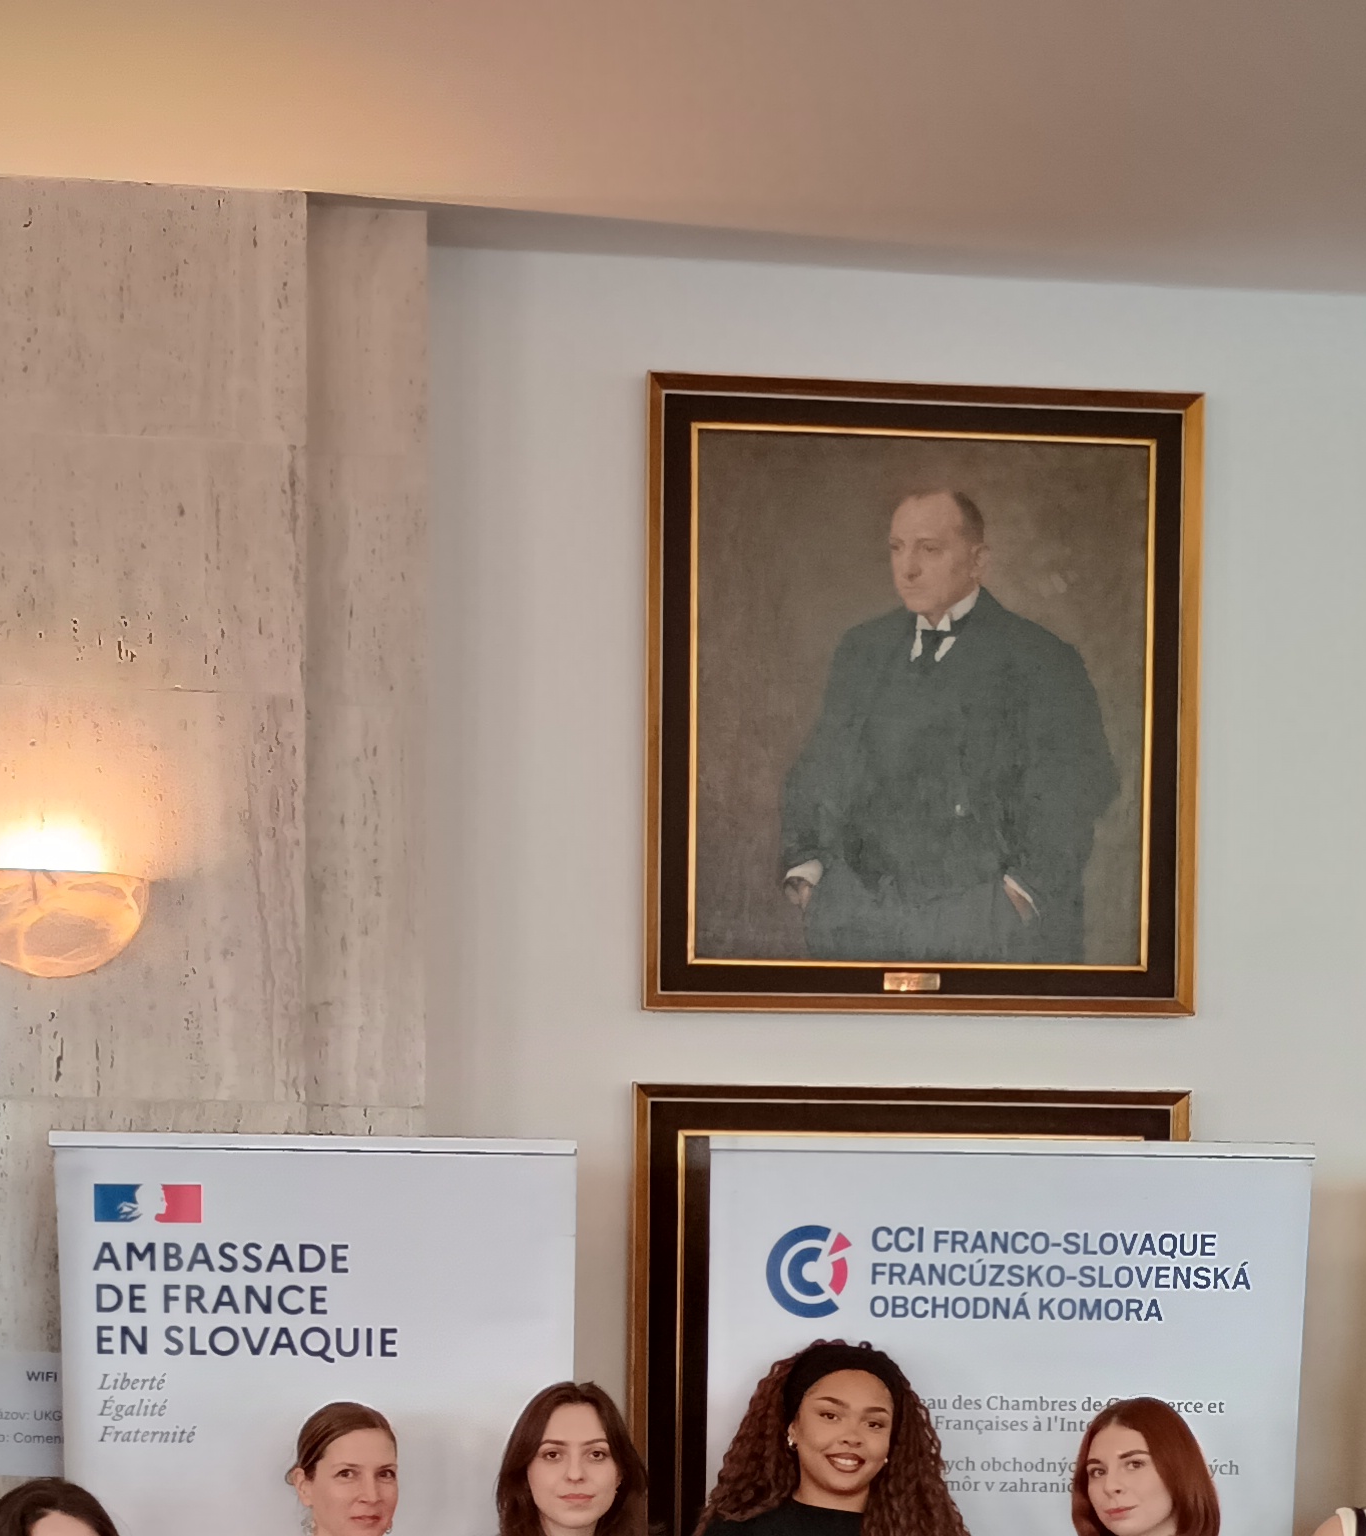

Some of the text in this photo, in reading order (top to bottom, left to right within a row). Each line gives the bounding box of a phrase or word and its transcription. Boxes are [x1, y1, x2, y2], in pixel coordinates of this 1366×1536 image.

[871, 1226, 1217, 1259] CCI FRANCO-SLOVAQUE
[93, 1242, 349, 1273] AMBASSADE
[870, 1258, 1252, 1291] FRANCÚZSKO-SLOVENSKÁ
[96, 1283, 328, 1315] DE FRANCE
[869, 1293, 1164, 1322] OBCHODNÁ KOMORA
[96, 1325, 398, 1363] EN SLOVAQUIE
[26, 1370, 58, 1382] WIFI
[97, 1372, 167, 1391] Liberté
[97, 1395, 169, 1422] Égalité
[952, 1395, 982, 1411] des
[986, 1395, 1077, 1412] Chambres
[1081, 1396, 1103, 1412] de
[1207, 1401, 1225, 1414] et
[33, 1409, 63, 1422] UKG
[934, 1415, 1028, 1435] Françaises
[1032, 1415, 1042, 1432] à
[98, 1425, 197, 1444] Fraternité
[980, 1456, 1077, 1476] obchodnýc
[985, 1481, 995, 1492] v
